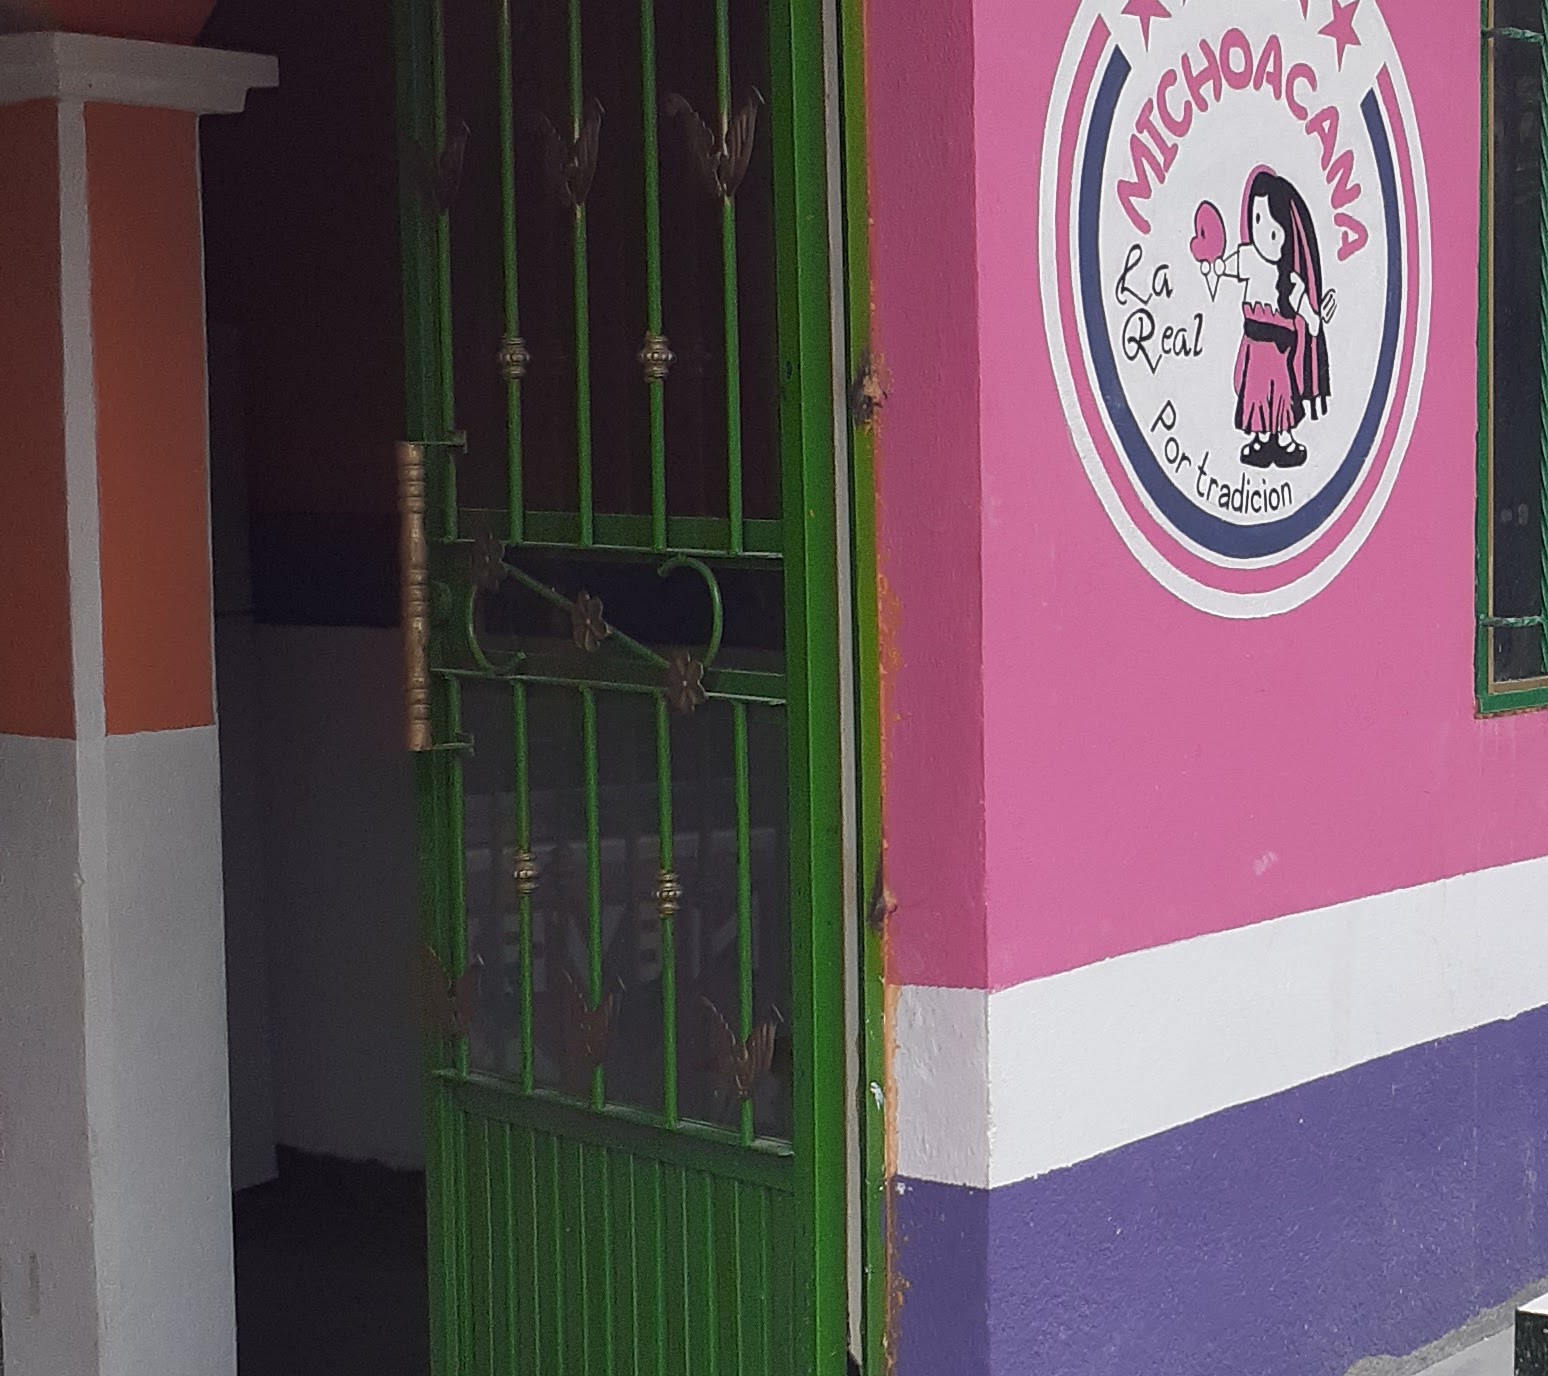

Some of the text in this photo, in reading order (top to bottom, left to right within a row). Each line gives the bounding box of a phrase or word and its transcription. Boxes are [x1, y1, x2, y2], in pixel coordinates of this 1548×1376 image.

[1116, 27, 1369, 262] MICHOACANA
[1115, 243, 1173, 306] La
[1122, 308, 1204, 375] Real
[1150, 399, 1293, 515] Por tradicion
